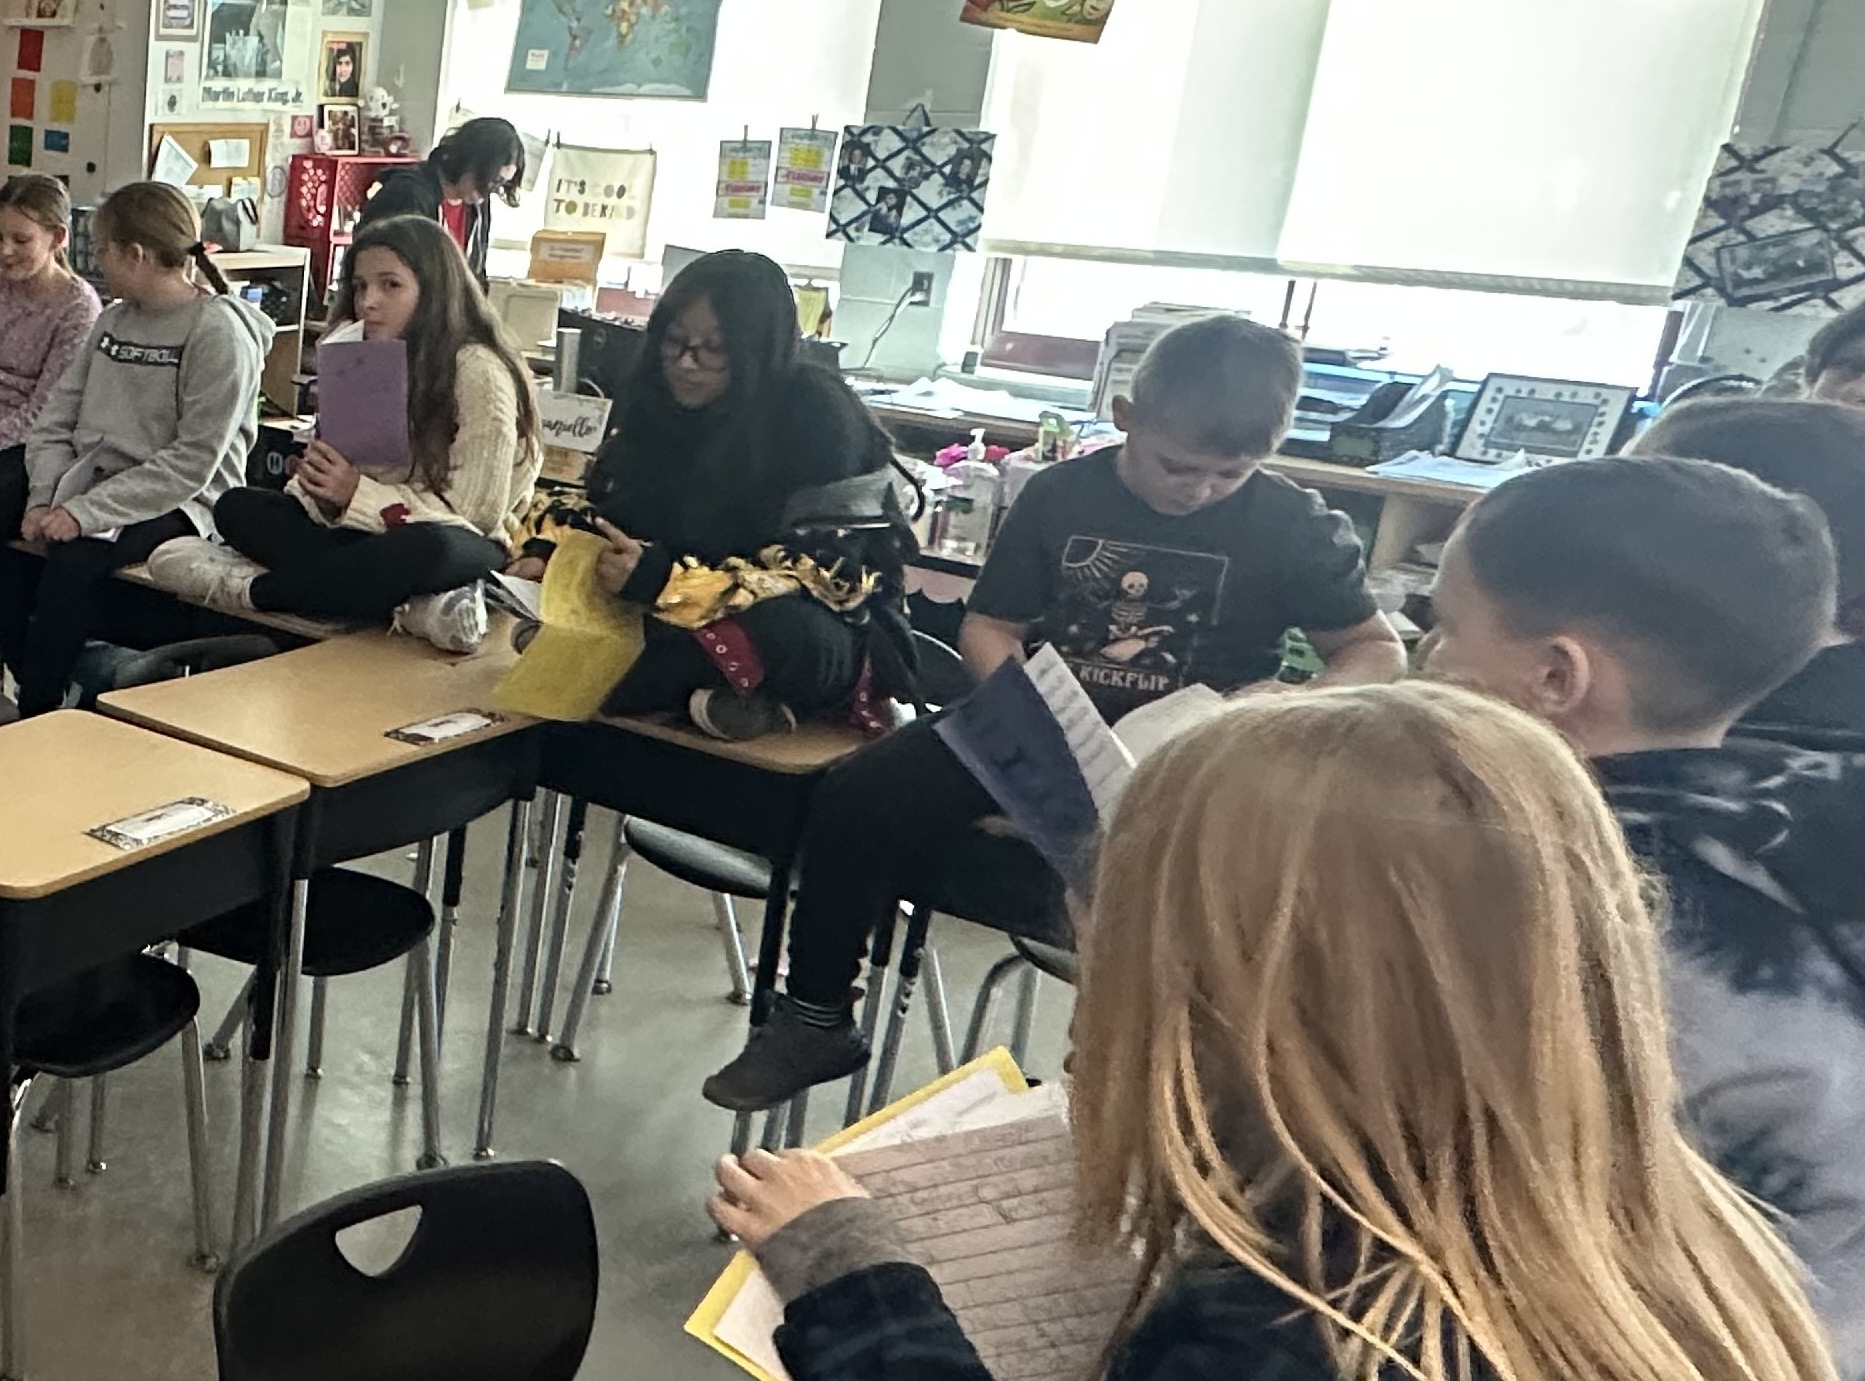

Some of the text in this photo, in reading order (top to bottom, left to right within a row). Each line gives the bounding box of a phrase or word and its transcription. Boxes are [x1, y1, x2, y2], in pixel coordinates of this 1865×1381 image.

[201, 86, 235, 103] Martin
[236, 86, 267, 104] Luther
[555, 178, 587, 196] IT'S
[552, 198, 579, 216] TO
[1079, 664, 1180, 692] KICKFLIP
